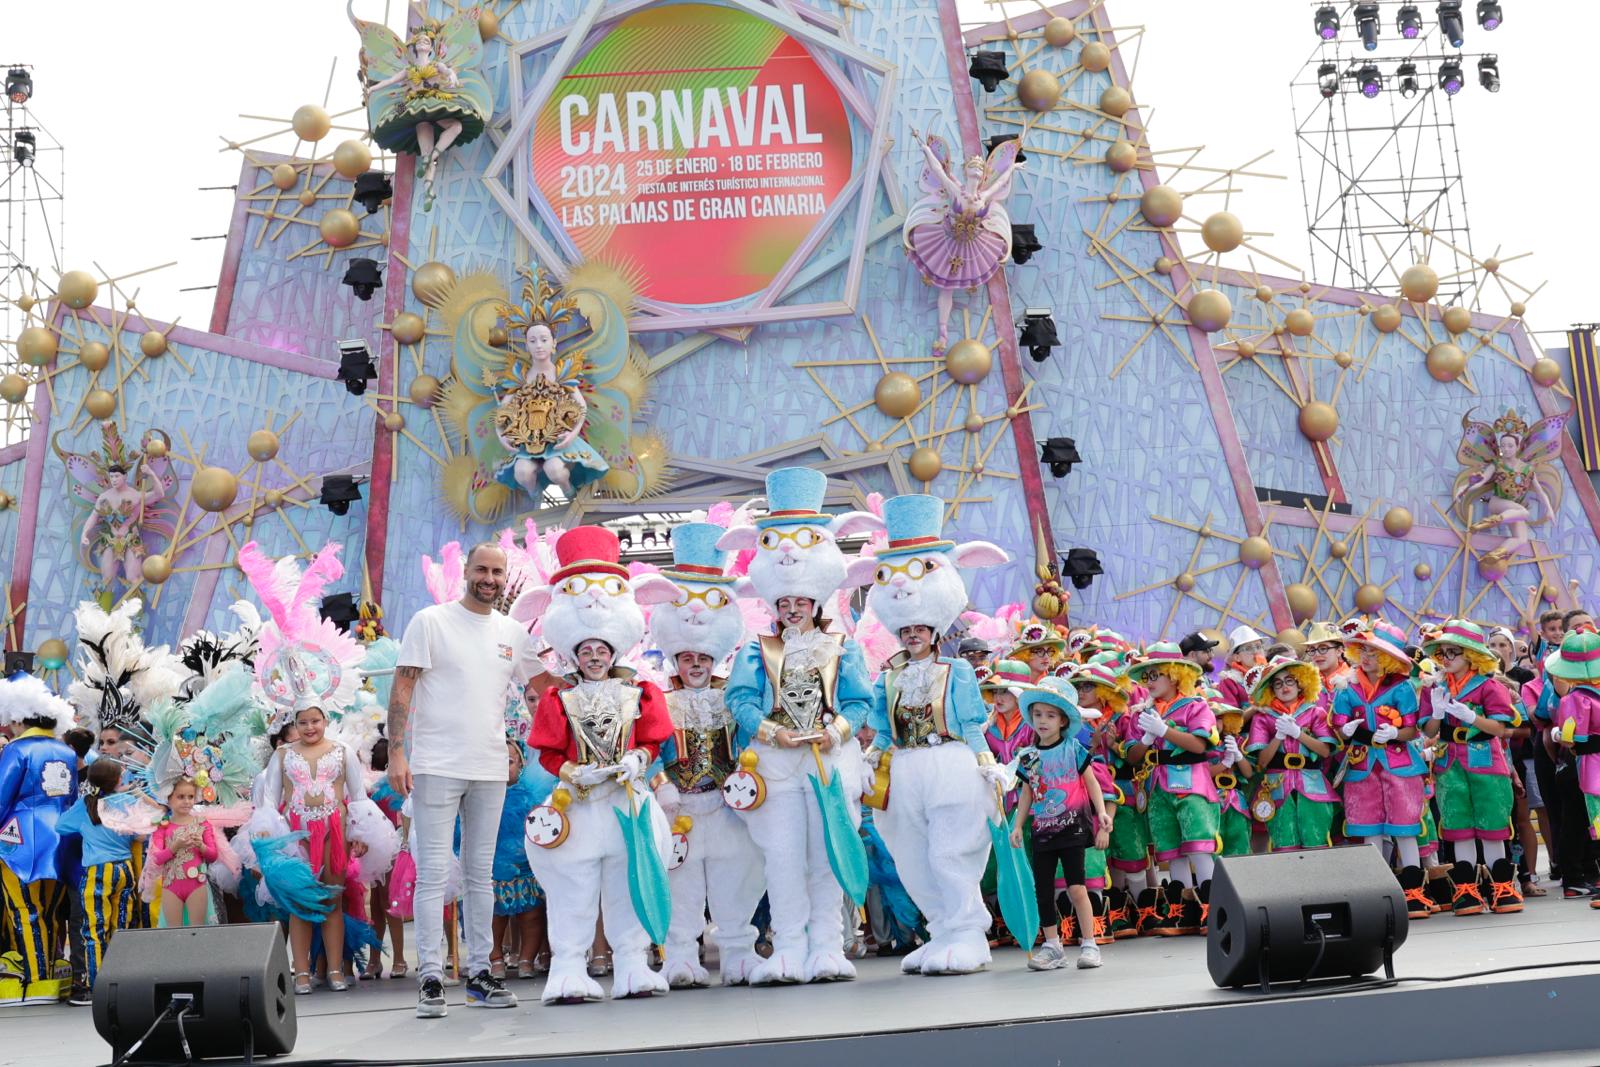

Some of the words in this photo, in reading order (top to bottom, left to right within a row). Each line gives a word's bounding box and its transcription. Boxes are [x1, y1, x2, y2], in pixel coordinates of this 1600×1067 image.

[560, 84, 822, 155] CARNAVAL
[560, 163, 627, 198] 2024
[636, 158, 653, 177] 25
[655, 158, 674, 176] DE
[675, 157, 717, 174] ENERO
[728, 155, 743, 171] 18
[746, 154, 763, 171] DE
[766, 152, 823, 171] FEBRERO
[637, 182, 665, 195] FIESTA
[667, 182, 678, 192] DE
[680, 178, 714, 192] INTERÉS
[716, 177, 758, 190] TURÍSTICO
[760, 174, 824, 189] INTERNACIONAL
[562, 205, 594, 228] LAS
[599, 201, 668, 226] PALMAS
[673, 199, 695, 221] DE
[700, 197, 746, 219] GRAN
[751, 192, 826, 218] CANARIA
